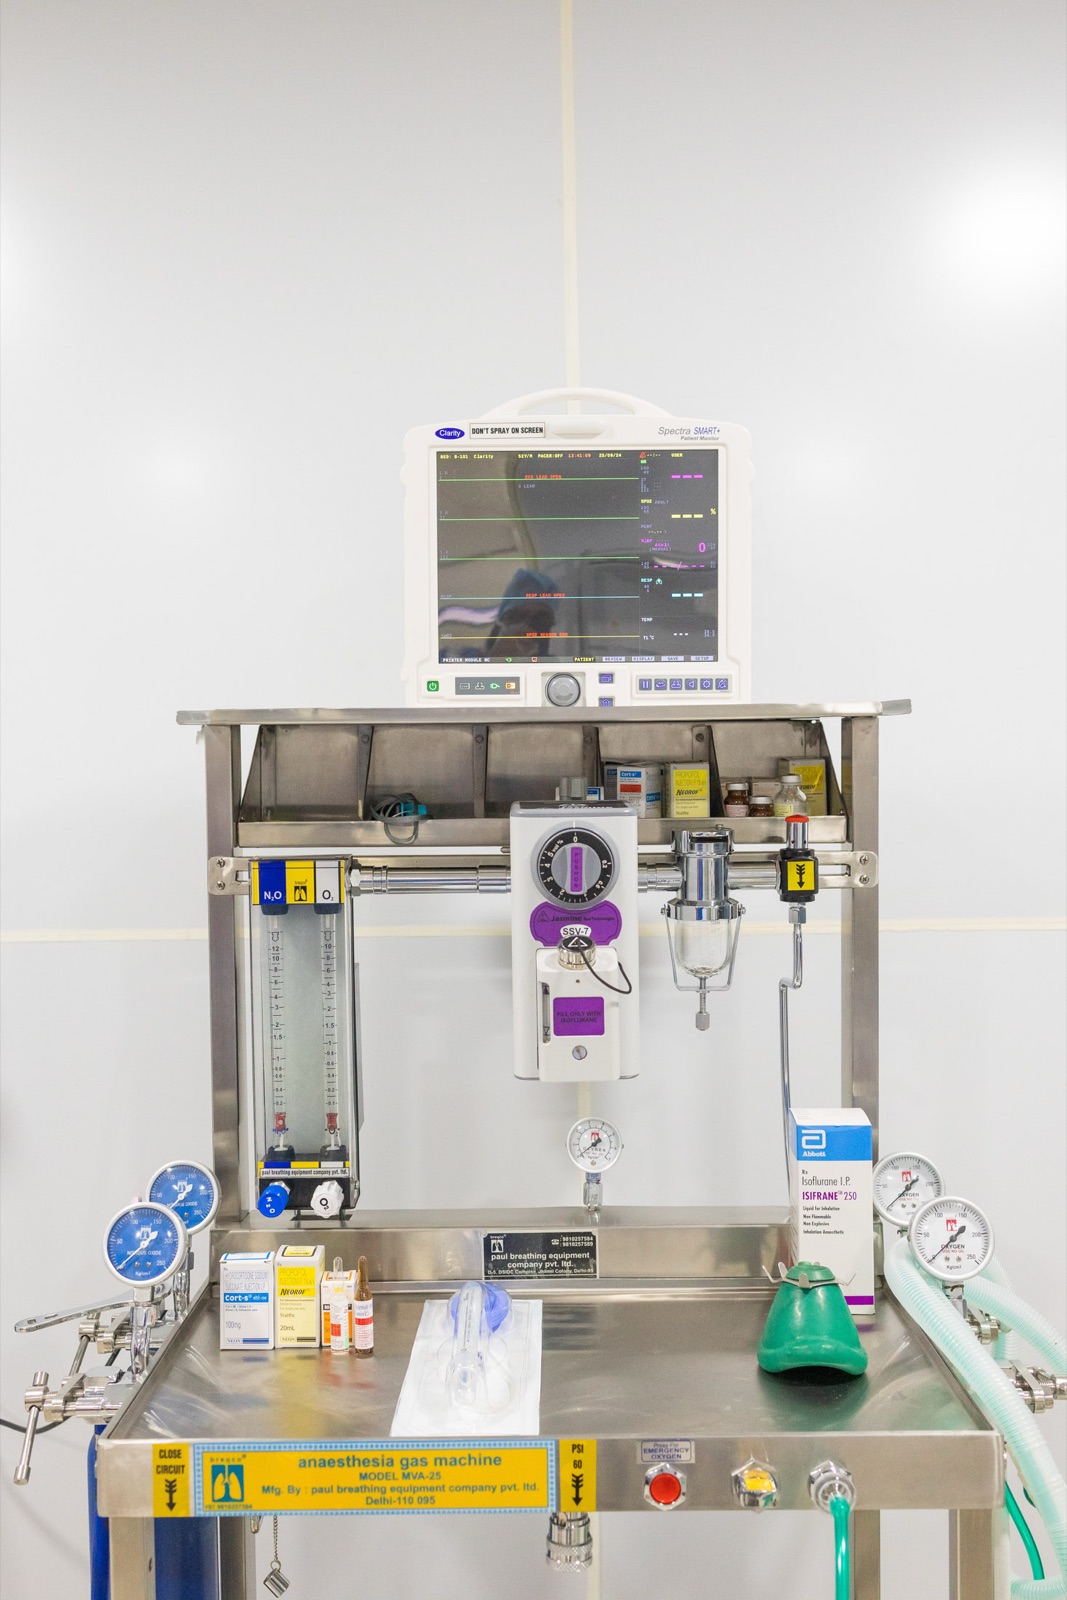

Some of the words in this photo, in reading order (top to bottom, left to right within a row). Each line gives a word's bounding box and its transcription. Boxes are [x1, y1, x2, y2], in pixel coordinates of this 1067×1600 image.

[439, 429, 461, 438] Clarity
[471, 428, 489, 436] DON'T
[490, 427, 510, 436] SPRAY
[511, 427, 520, 435] ON
[520, 427, 544, 435] SCREEN
[658, 426, 691, 437] Spectra
[559, 888, 565, 896] 2
[562, 927, 589, 936] SSV-7
[802, 1176, 838, 1186] Isoflurane
[840, 1176, 851, 1186] I.P.
[844, 1191, 857, 1201] 250
[491, 1253, 508, 1261] paul
[509, 1252, 547, 1261] breathing
[548, 1251, 590, 1260] equipment
[225, 1320, 241, 1330] 100mg
[571, 1444, 584, 1454] PSI
[159, 1449, 182, 1460] CLOSE
[298, 1455, 394, 1469] anaesthesia
[400, 1457, 428, 1471] gas
[434, 1453, 502, 1467] machine
[573, 1459, 582, 1469] 60
[156, 1464, 185, 1475] CIRCUIT
[359, 1472, 398, 1481] MODEL
[402, 1471, 441, 1481] MVA-25
[262, 1486, 284, 1496] Mfg.
[288, 1485, 301, 1496] By
[311, 1485, 333, 1496] paul
[337, 1484, 386, 1495] breathing
[390, 1484, 445, 1495] equipment
[448, 1484, 496, 1494] company
[500, 1483, 519, 1493] pvt.
[523, 1482, 539, 1491] ltd.
[365, 1496, 414, 1506] Delhi-110
[417, 1496, 436, 1505] 095
